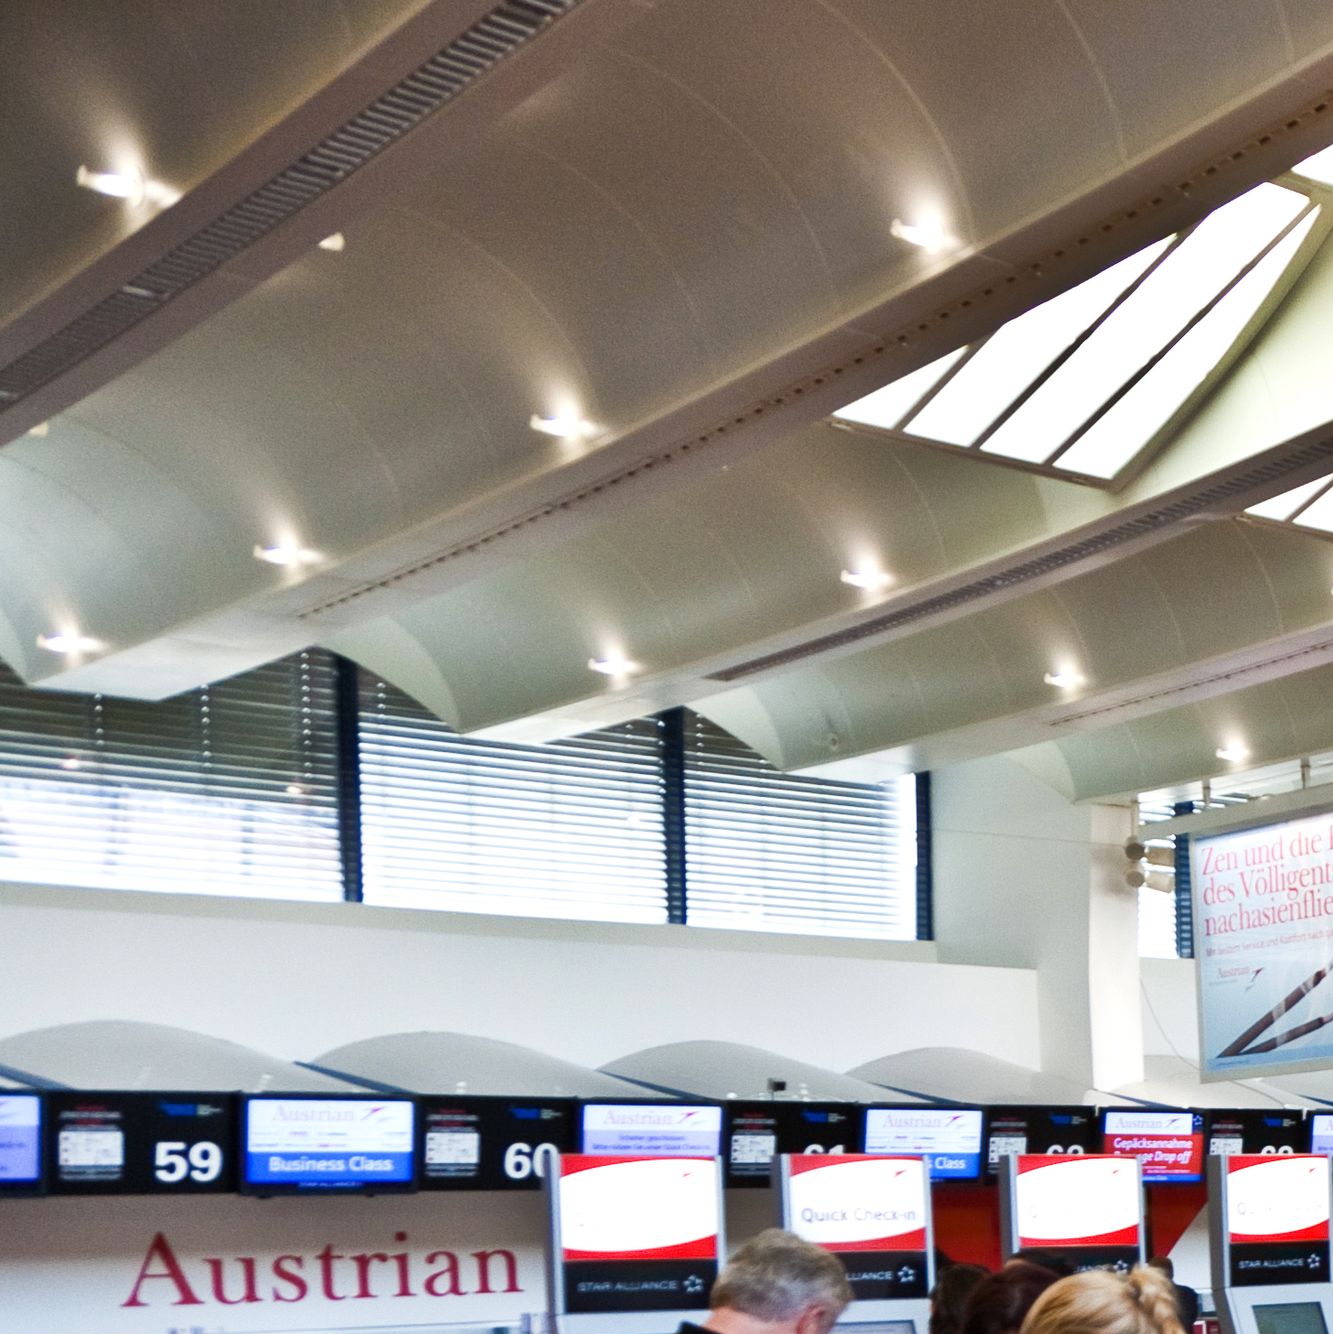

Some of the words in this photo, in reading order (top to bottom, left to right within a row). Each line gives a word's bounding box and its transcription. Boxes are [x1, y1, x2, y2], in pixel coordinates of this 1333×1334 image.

[1201, 846, 1239, 876] Zen
[1242, 836, 1284, 868] und
[1289, 826, 1323, 857] die
[1203, 877, 1237, 906] des
[603, 1109, 674, 1126] Austrian
[882, 1114, 942, 1128] Austrian
[155, 1140, 223, 1183] 59
[268, 1156, 346, 1172] Business
[349, 1156, 394, 1172] Class
[504, 1142, 558, 1179] 60
[935, 1156, 967, 1170] Class
[1153, 1151, 1175, 1163] Drop
[1176, 1150, 1192, 1163] off
[801, 1208, 848, 1223] Quick
[854, 1207, 916, 1222] Check-in
[120, 1231, 525, 1308] Austrian
[1239, 1260, 1262, 1269] STAR
[1263, 1258, 1304, 1268] ALLIANCE
[845, 1271, 894, 1281] LLIANCE
[614, 1279, 679, 1291] ALLIANCE
